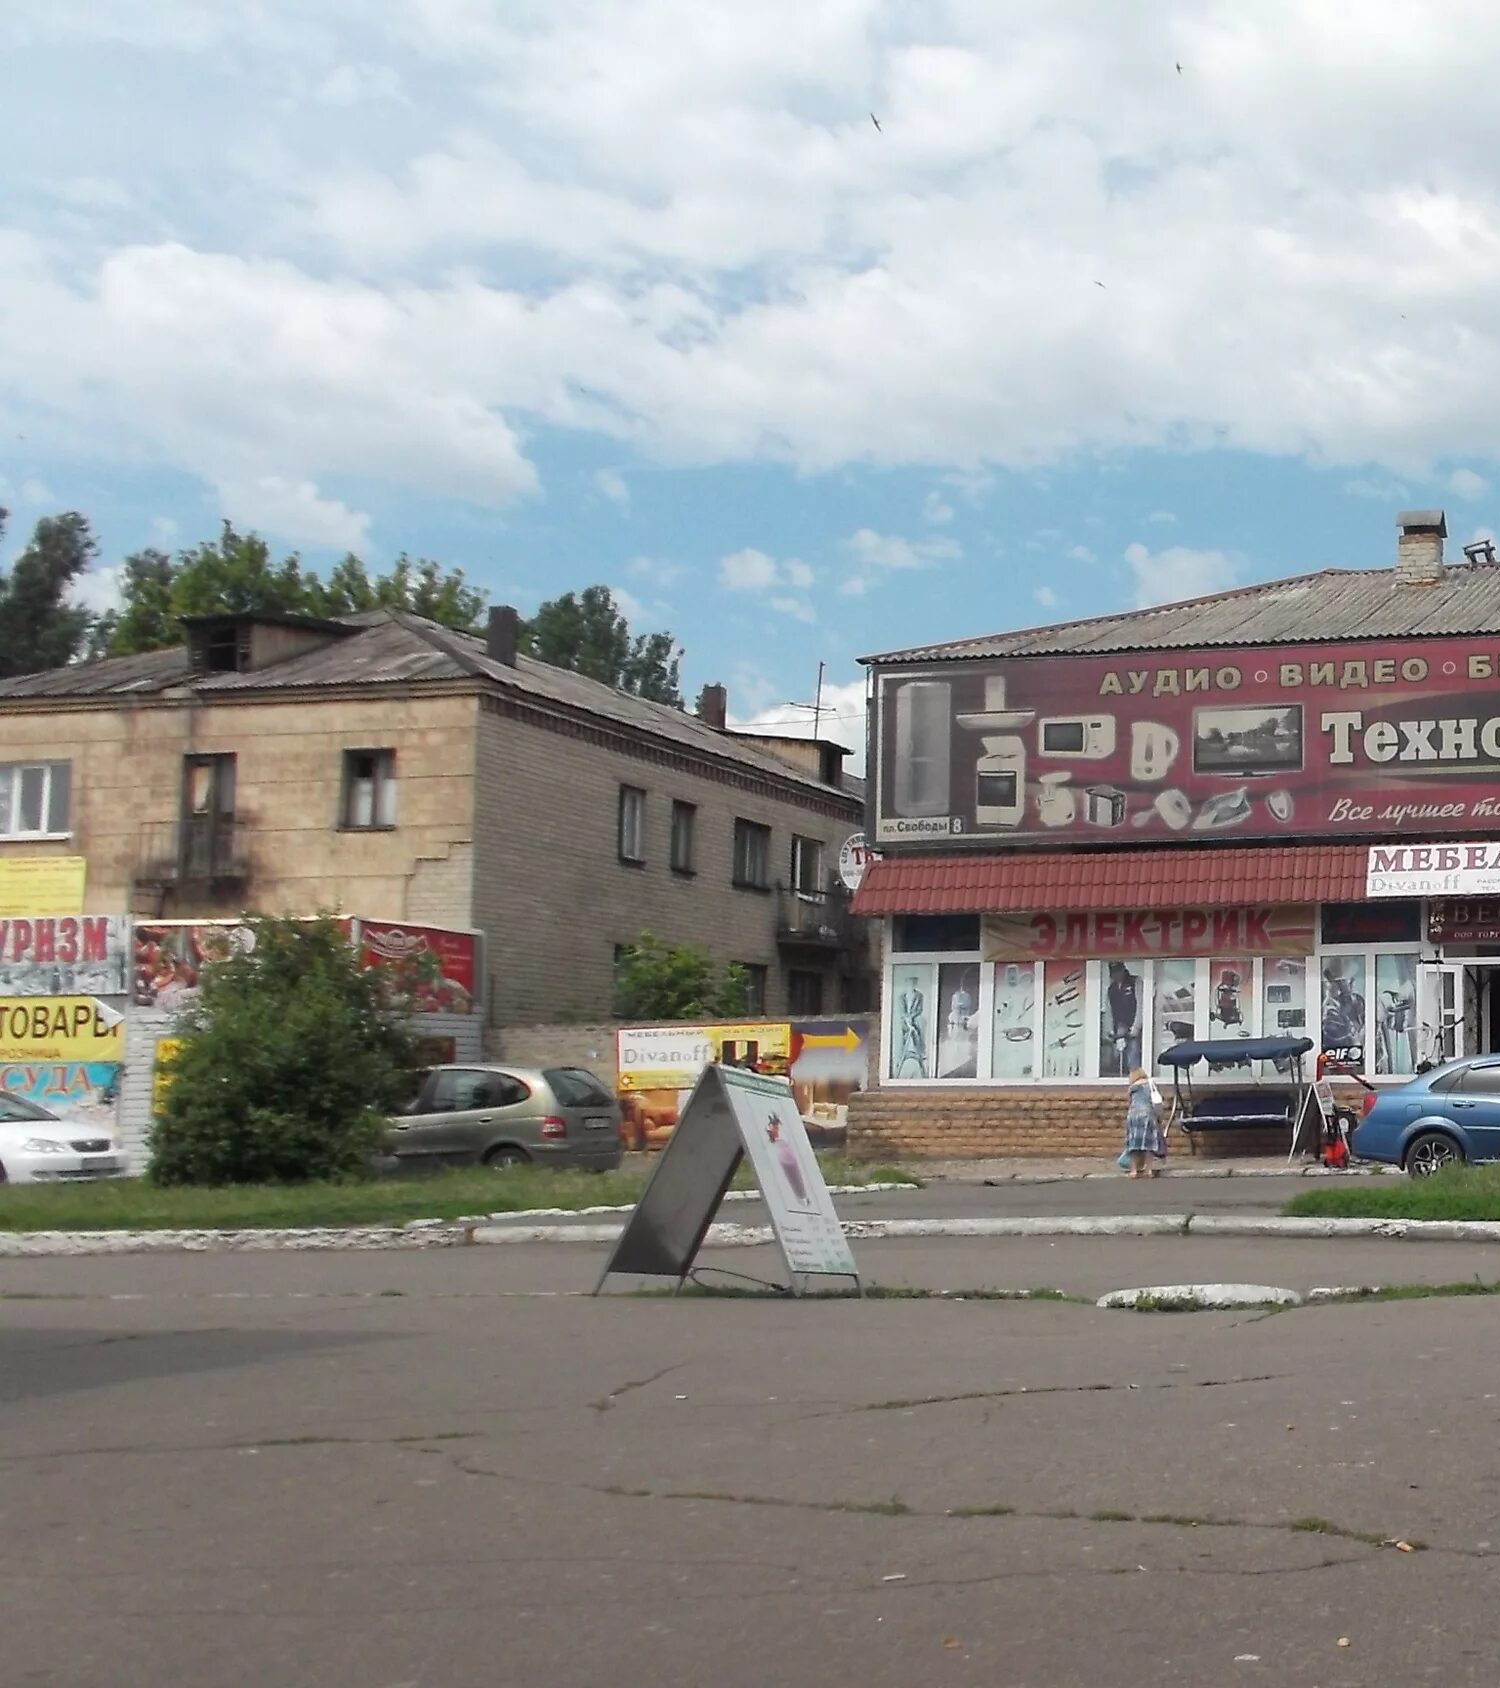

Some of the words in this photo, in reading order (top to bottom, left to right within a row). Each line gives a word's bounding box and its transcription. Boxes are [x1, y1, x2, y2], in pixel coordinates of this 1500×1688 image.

[1099, 665, 1243, 697] АУДИО
[1279, 657, 1430, 689] ВИДЕО
[1329, 797, 1374, 823] Все
[1377, 801, 1464, 821] лучшее
[953, 818, 962, 833] 8
[1370, 874, 1461, 893] Divanoff
[1029, 909, 1274, 953] ЭЛЕКТРИК
[623, 1041, 712, 1064] Divanoff
[1325, 1048, 1348, 1060] elf
